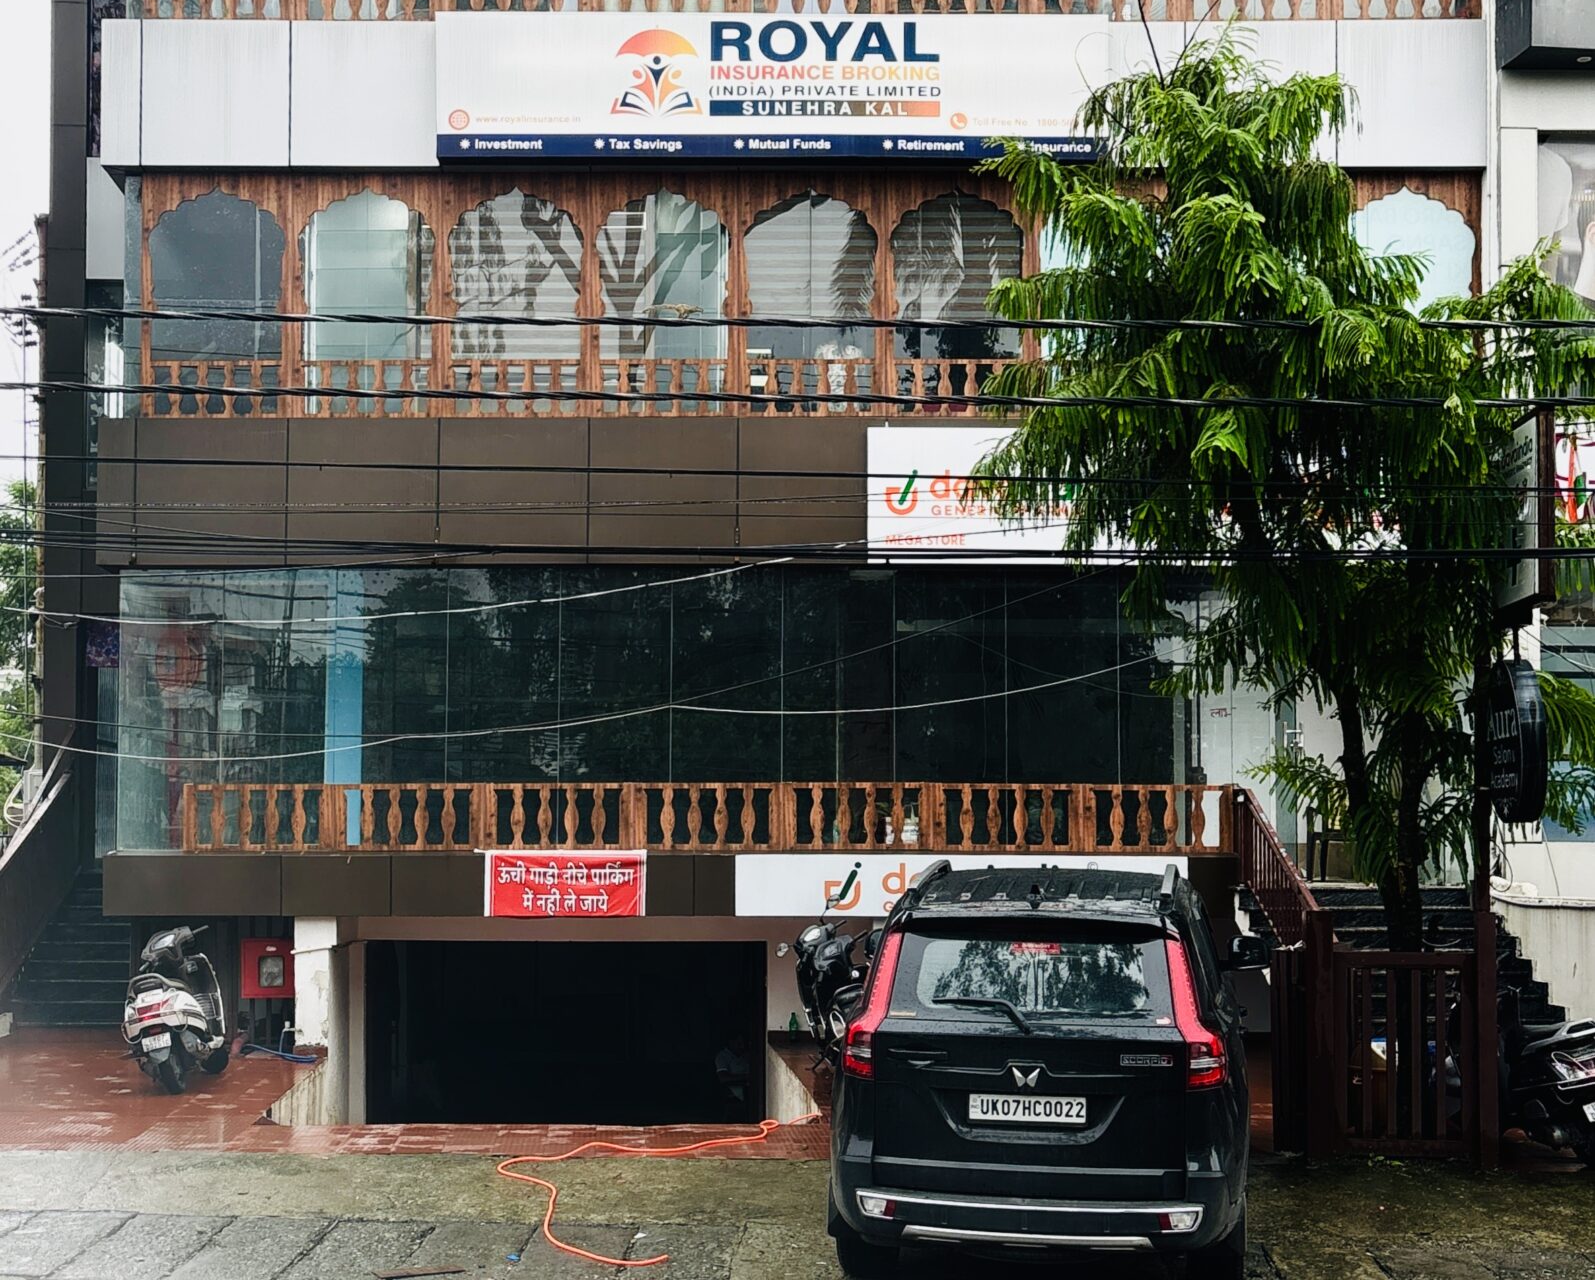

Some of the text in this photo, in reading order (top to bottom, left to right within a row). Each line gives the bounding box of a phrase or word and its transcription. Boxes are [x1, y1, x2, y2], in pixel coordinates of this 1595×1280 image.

[709, 20, 940, 62] ROYAL
[710, 65, 940, 81] INSURANCE BROKING
[782, 85, 859, 97] PRIVATE
[866, 86, 941, 98] LIMITED
[742, 100, 909, 116] SUNEHRA KAL
[474, 138, 543, 150] Investment
[608, 138, 683, 152] Tax Savings
[748, 139, 832, 150] Mutual Funds
[897, 139, 965, 151] Retirement
[885, 533, 967, 546] MEGA STORE
[1486, 700, 1518, 741] Aura
[562, 862, 588, 886] नीचे
[522, 888, 534, 911] में
[563, 889, 577, 912] ले
[579, 889, 609, 913] जाये
[980, 1098, 1085, 1119] UK07HC0022
